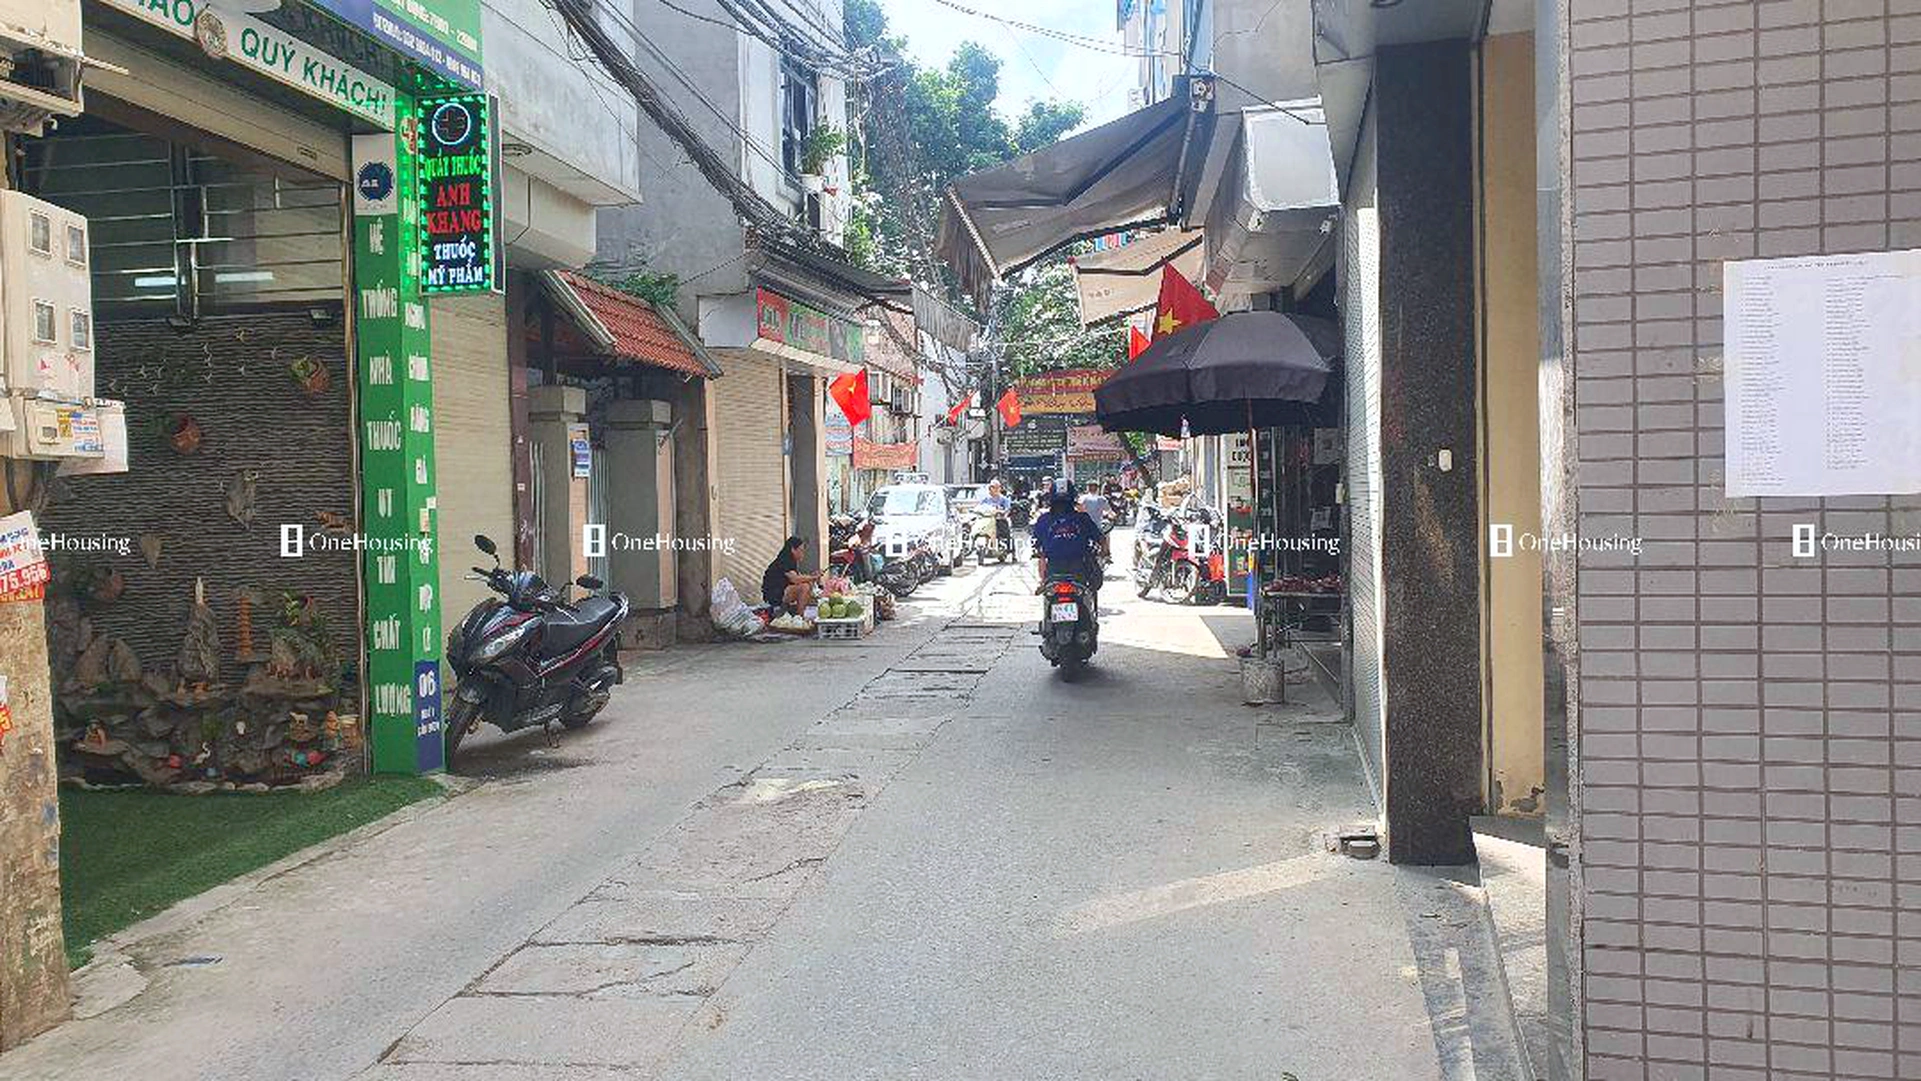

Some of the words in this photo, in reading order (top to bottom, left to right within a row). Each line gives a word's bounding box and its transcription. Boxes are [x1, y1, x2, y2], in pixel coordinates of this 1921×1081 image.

[241, 28, 296, 73] QUÝ
[304, 57, 387, 116] KHÁCH!
[437, 183, 471, 207] ANH
[427, 210, 482, 234] KHANG
[434, 235, 476, 260] THUỐC
[428, 264, 446, 285] MỸ
[366, 410, 401, 451] THUỐC
[378, 488, 393, 518] UY
[419, 670, 436, 697] 06
